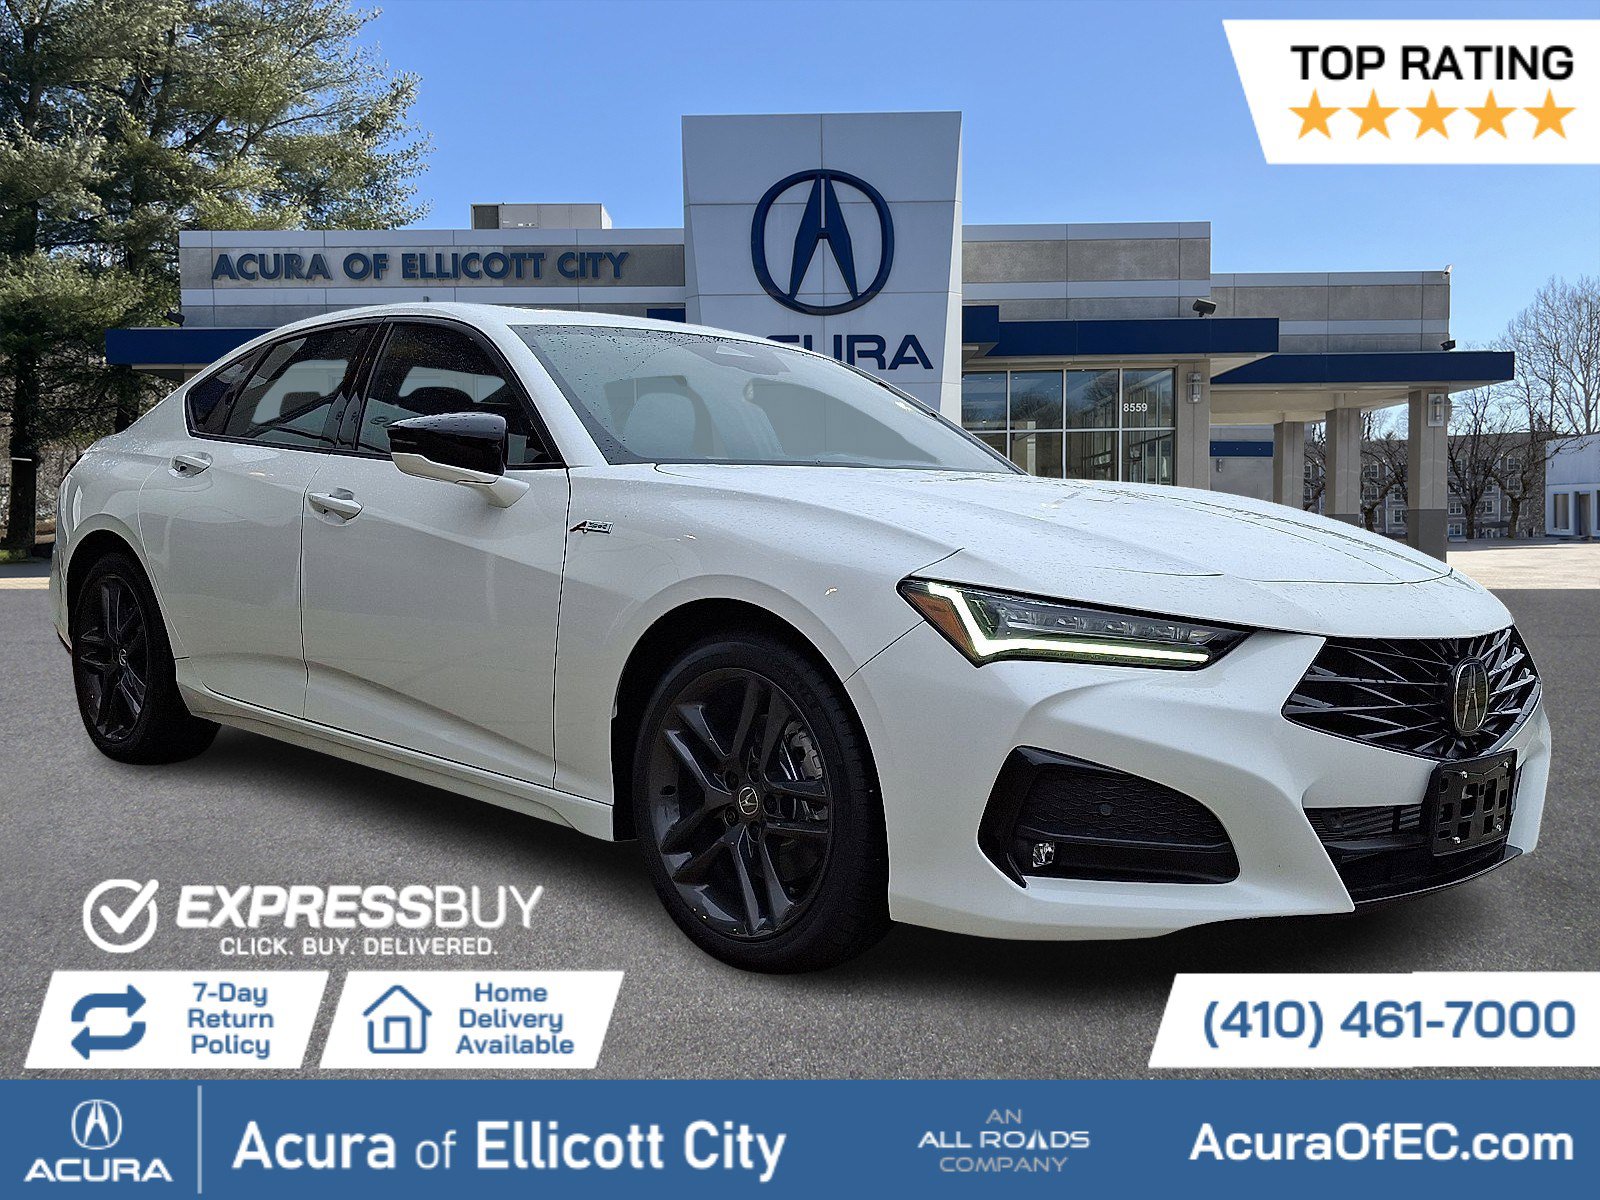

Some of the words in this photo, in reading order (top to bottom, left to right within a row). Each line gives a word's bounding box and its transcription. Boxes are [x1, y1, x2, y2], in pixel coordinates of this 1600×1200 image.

[211, 252, 331, 281] ACURA
[342, 252, 391, 281] OF
[401, 252, 546, 281] ELLICOTT
[556, 252, 629, 281] CITY
[1123, 402, 1148, 412] 8559
